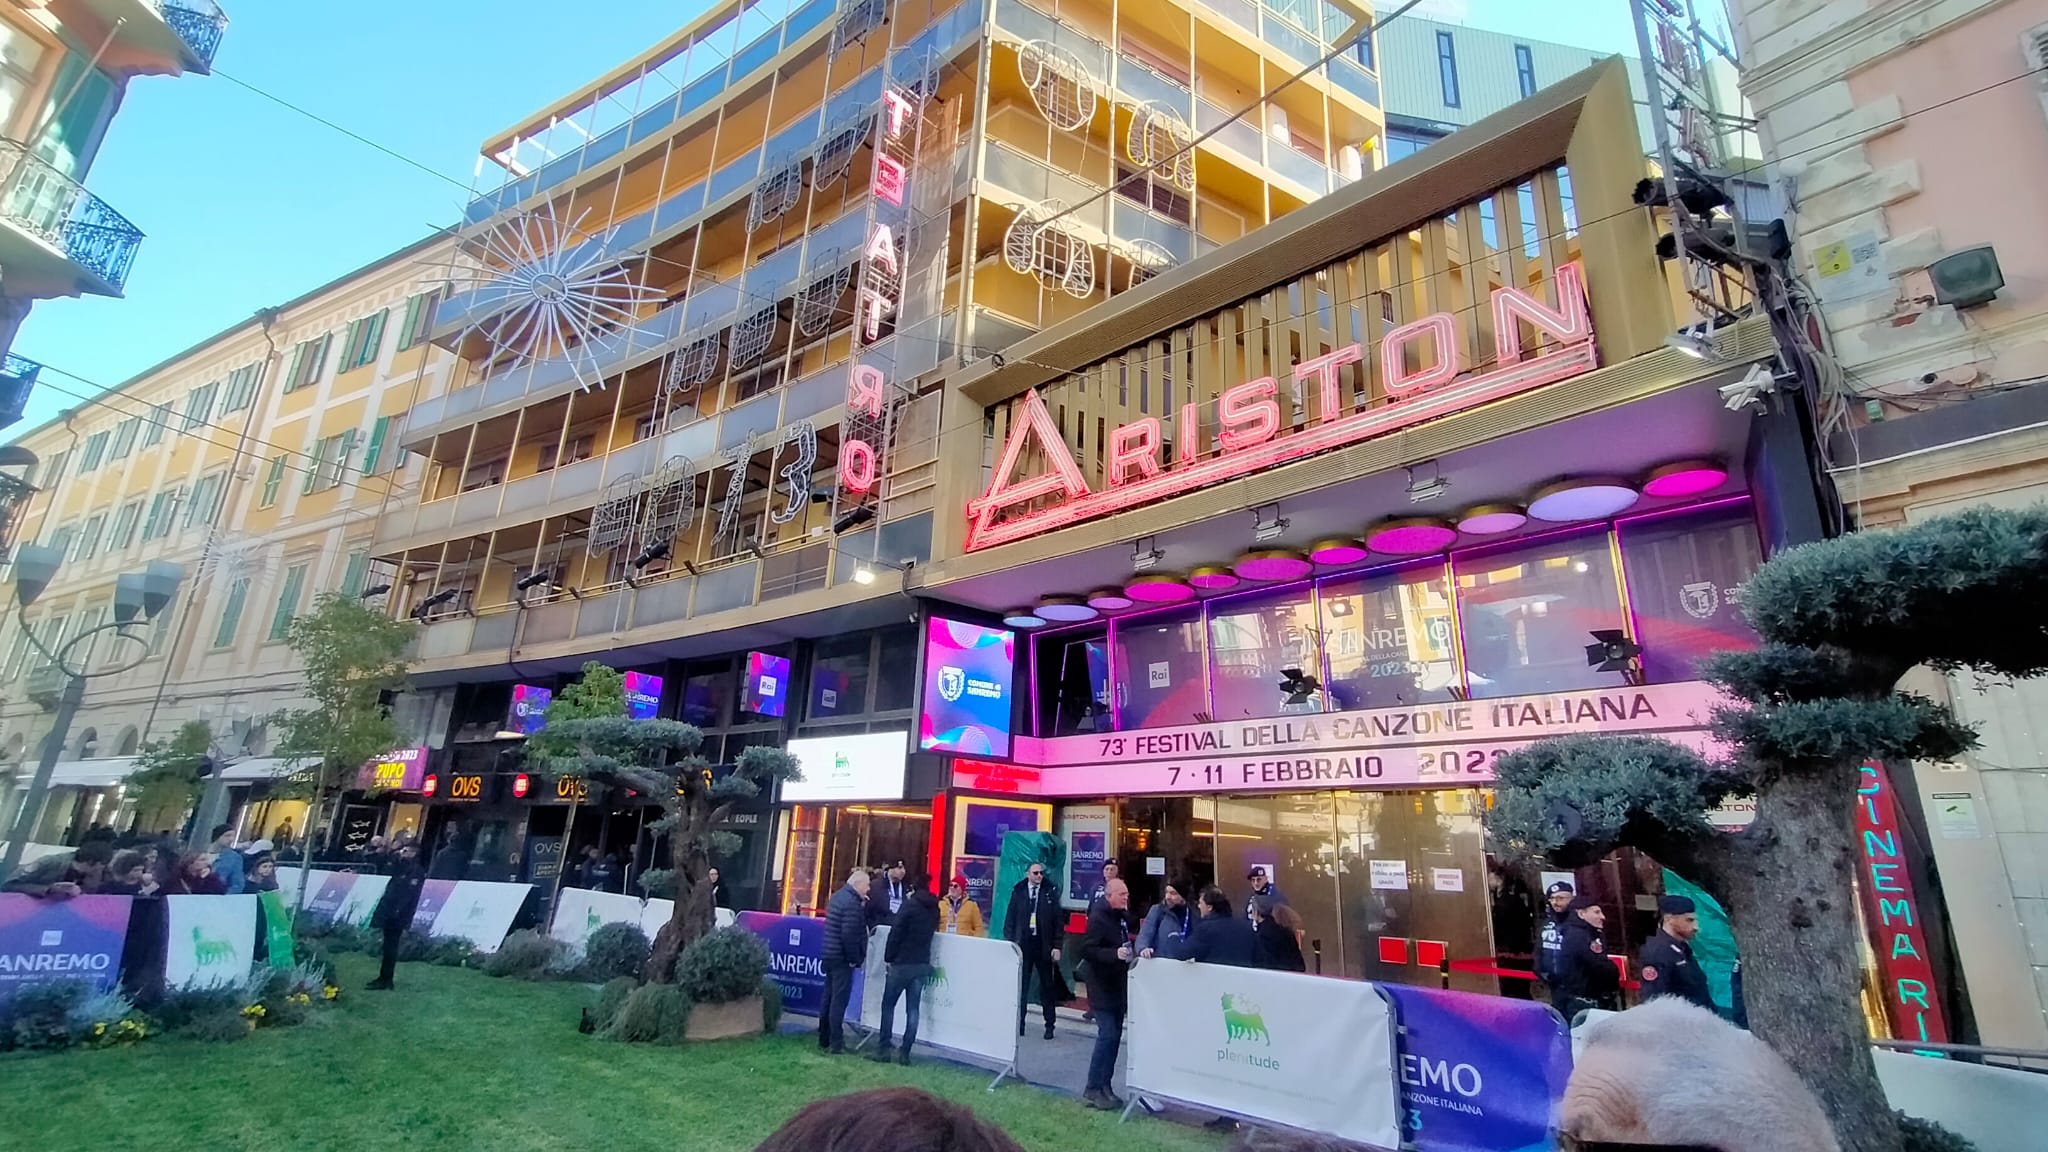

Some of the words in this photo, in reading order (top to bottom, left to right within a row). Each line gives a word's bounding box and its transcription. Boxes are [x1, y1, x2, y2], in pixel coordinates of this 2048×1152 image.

[966, 262, 1594, 553] ARISTON
[1151, 668, 1167, 680] Rai
[761, 681, 775, 690] Rai
[1136, 729, 1231, 756] FESTIVAL
[1243, 721, 1319, 748] DELLA
[1333, 706, 1474, 741] CANZONE
[1492, 693, 1658, 728] ITALIANA
[376, 762, 405, 779] PUPO
[1168, 767, 1181, 786] 7
[1204, 764, 1223, 785] 11
[1243, 756, 1384, 784] FEBBRAIO
[452, 776, 482, 797] OVS
[732, 814, 758, 823] EOPLE
[535, 842, 561, 854] OVS
[1072, 851, 1104, 860] SANREMO
[1217, 1047, 1281, 1071] plenitude
[1440, 1098, 1483, 1117] ITALIANA
